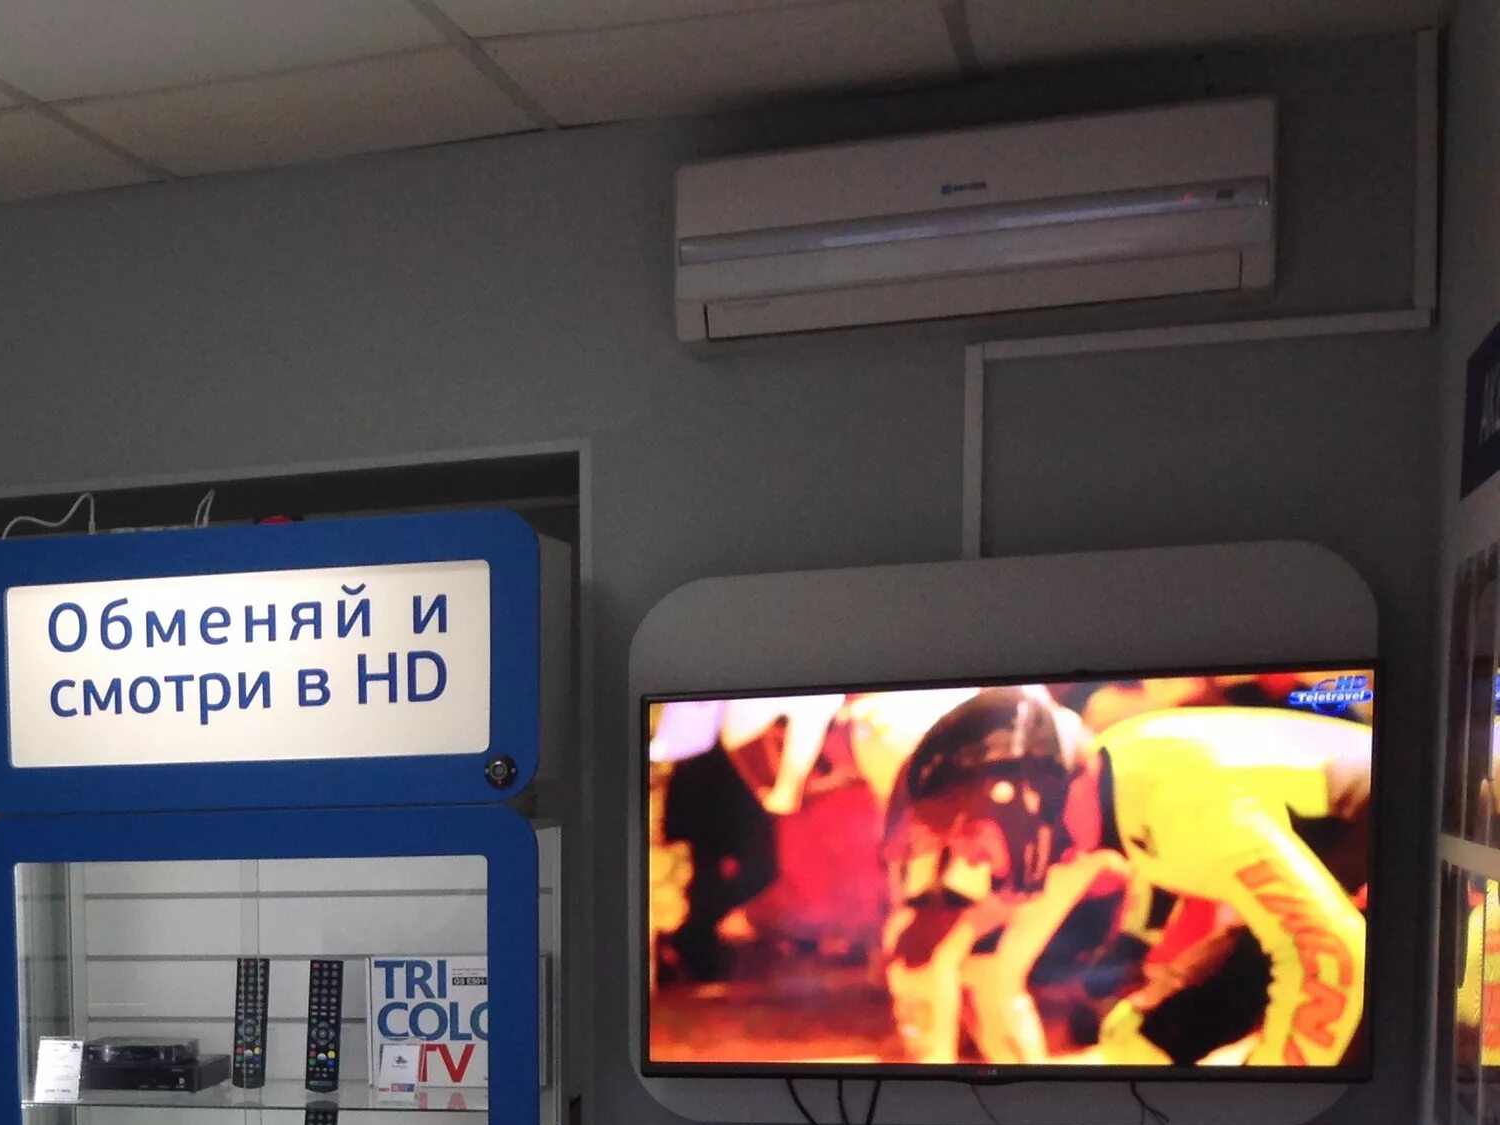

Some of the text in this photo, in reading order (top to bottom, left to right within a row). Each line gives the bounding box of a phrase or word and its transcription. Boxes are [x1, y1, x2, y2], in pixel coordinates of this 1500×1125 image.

[48, 583, 448, 653] Обменяй и
[49, 650, 448, 726] смотри в HD
[1298, 689, 1365, 703] Teletravel
[374, 960, 447, 999] TRI
